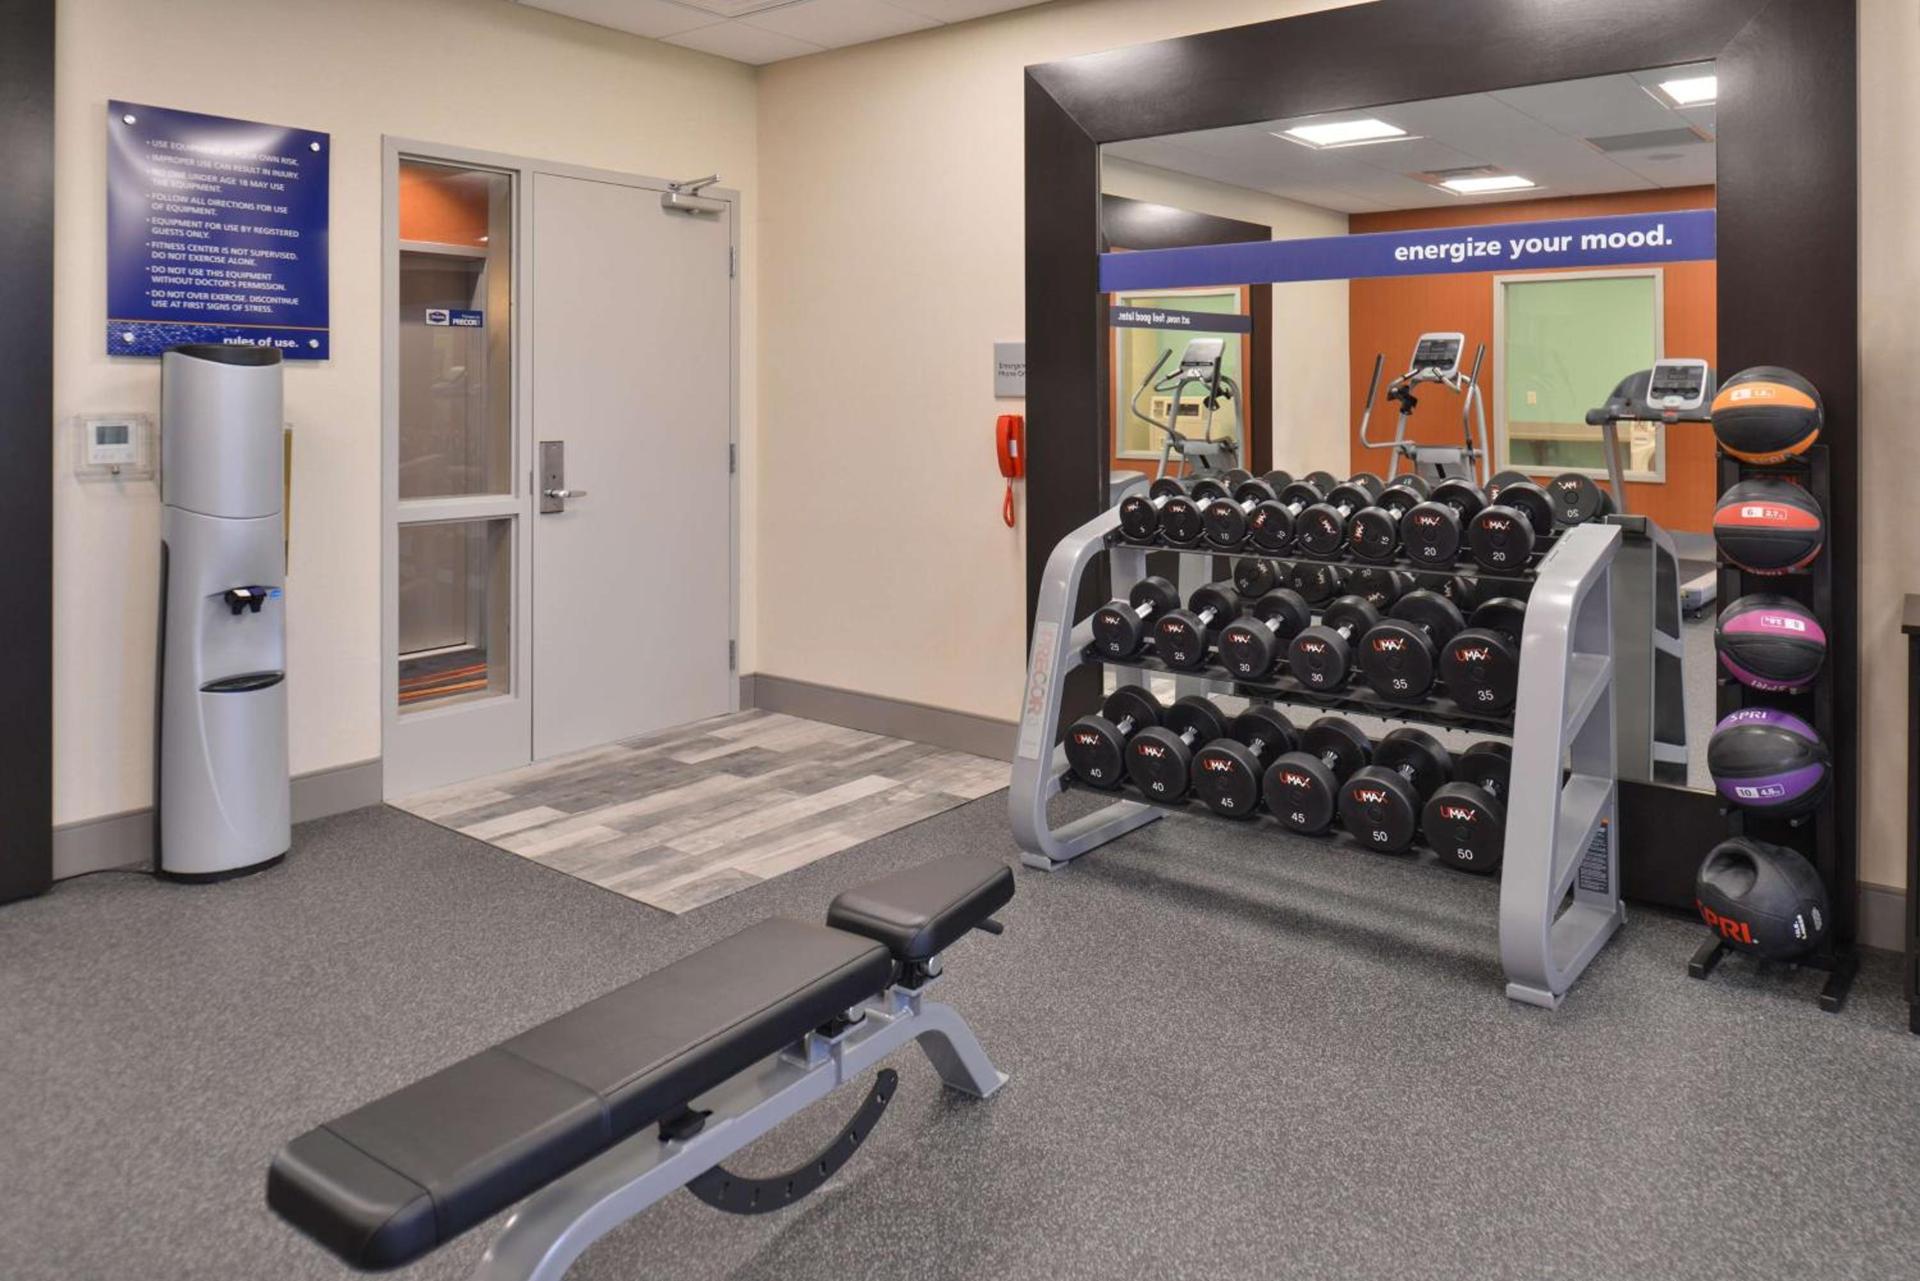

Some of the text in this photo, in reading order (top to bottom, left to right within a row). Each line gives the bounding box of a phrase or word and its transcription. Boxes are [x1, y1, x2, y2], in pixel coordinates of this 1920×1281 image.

[152, 140, 167, 148] USE
[258, 153, 280, 163] OWN
[281, 157, 299, 166] RISK.
[152, 154, 299, 179] IMPROPER USE CAN RESULT IN INJURY.
[171, 180, 222, 193] EQUIPMENT.
[188, 172, 217, 182] UNDER
[220, 176, 236, 185] AGE
[240, 179, 248, 187] 18
[250, 180, 269, 189] MAY
[270, 183, 285, 191] USE
[152, 192, 288, 214] FOLLOW ALL DIRECTIONS FOR USE
[152, 202, 217, 216] OF EQUIPMENT.
[152, 216, 299, 238] EQUIPMENT FOR USE BY REGISTERED
[152, 226, 210, 239] GUESTS ONLY.
[1394, 224, 1673, 263] energize your mood.
[152, 241, 186, 251] FITNESS
[187, 244, 219, 253] CENTER
[230, 247, 248, 256] NOT
[250, 249, 298, 260] SUPERVISED.
[151, 251, 257, 266] DO NOT EXERCISE ALONE.
[151, 265, 272, 281] DO NOT USE THIS EQUIPMENT
[151, 276, 193, 285] WITHOUT
[238, 281, 287, 291] PERMISSION.
[151, 290, 166, 298] DO
[167, 291, 186, 299] NOT
[186, 291, 209, 300] OVER
[249, 295, 299, 305] DISCONTINUE
[151, 300, 273, 313] USE AT FIRST SIGNS OF STRESS.
[223, 337, 299, 348] rules of use.
[1424, 547, 1437, 557] 20
[1492, 551, 1506, 561] 20
[1109, 642, 1120, 651] 25
[1371, 638, 1408, 652] UMAX
[1175, 651, 1185, 661] 25
[1455, 647, 1492, 662] UMAX
[1239, 663, 1250, 673] 30
[1311, 673, 1323, 683] 30
[1392, 678, 1408, 690] 35
[1477, 690, 1494, 701] 35
[1731, 711, 1767, 722] SPRI
[1090, 768, 1102, 778] 40
[1279, 771, 1312, 789] UMAX
[1152, 782, 1165, 793] 40
[1221, 797, 1234, 808] 45
[1353, 789, 1389, 805] UMAX
[1290, 811, 1305, 824] 45
[1440, 806, 1478, 823] UMAX
[1372, 830, 1388, 842] 50
[1457, 848, 1474, 861] 50
